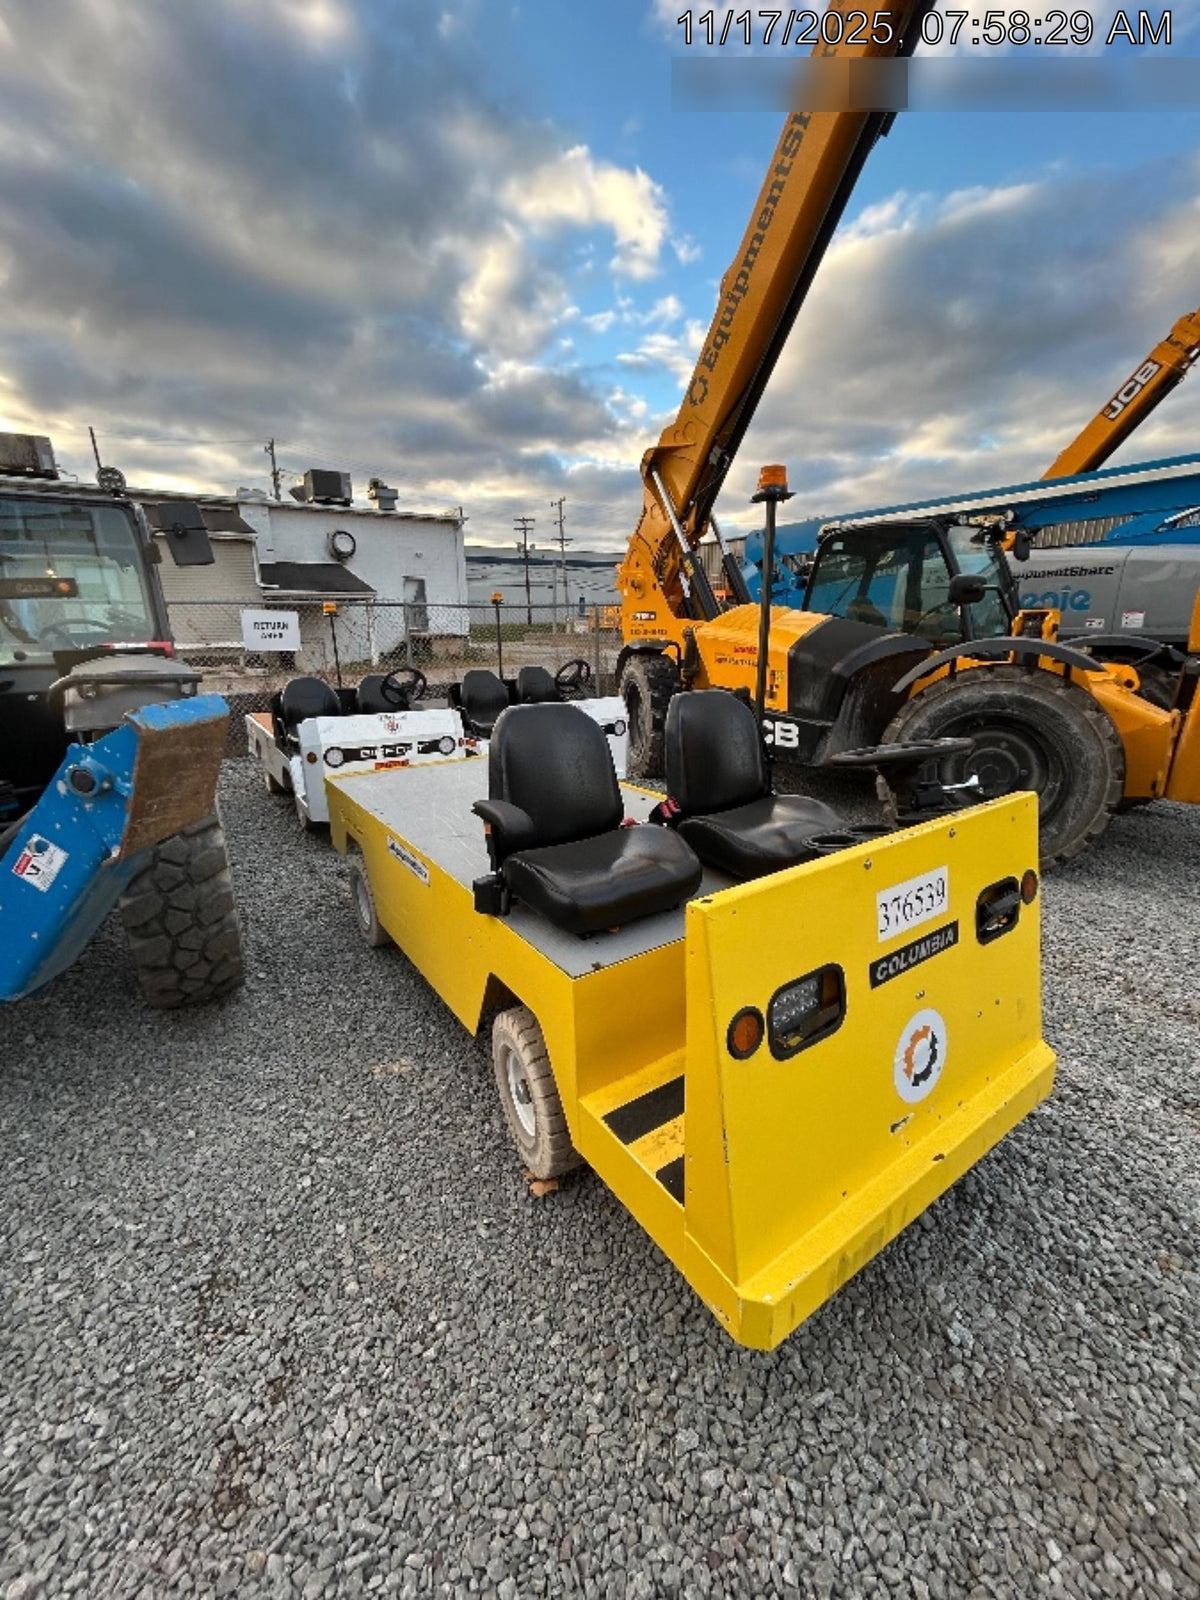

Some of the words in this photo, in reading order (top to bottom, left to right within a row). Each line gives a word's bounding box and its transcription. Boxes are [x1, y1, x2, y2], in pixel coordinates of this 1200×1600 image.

[1103, 361, 1162, 420] JCB
[1018, 584, 1091, 612] enie
[253, 621, 289, 630] RETURN
[762, 719, 799, 748] CB
[878, 877, 946, 934] 376539
[875, 929, 954, 982] COLUMBIA
